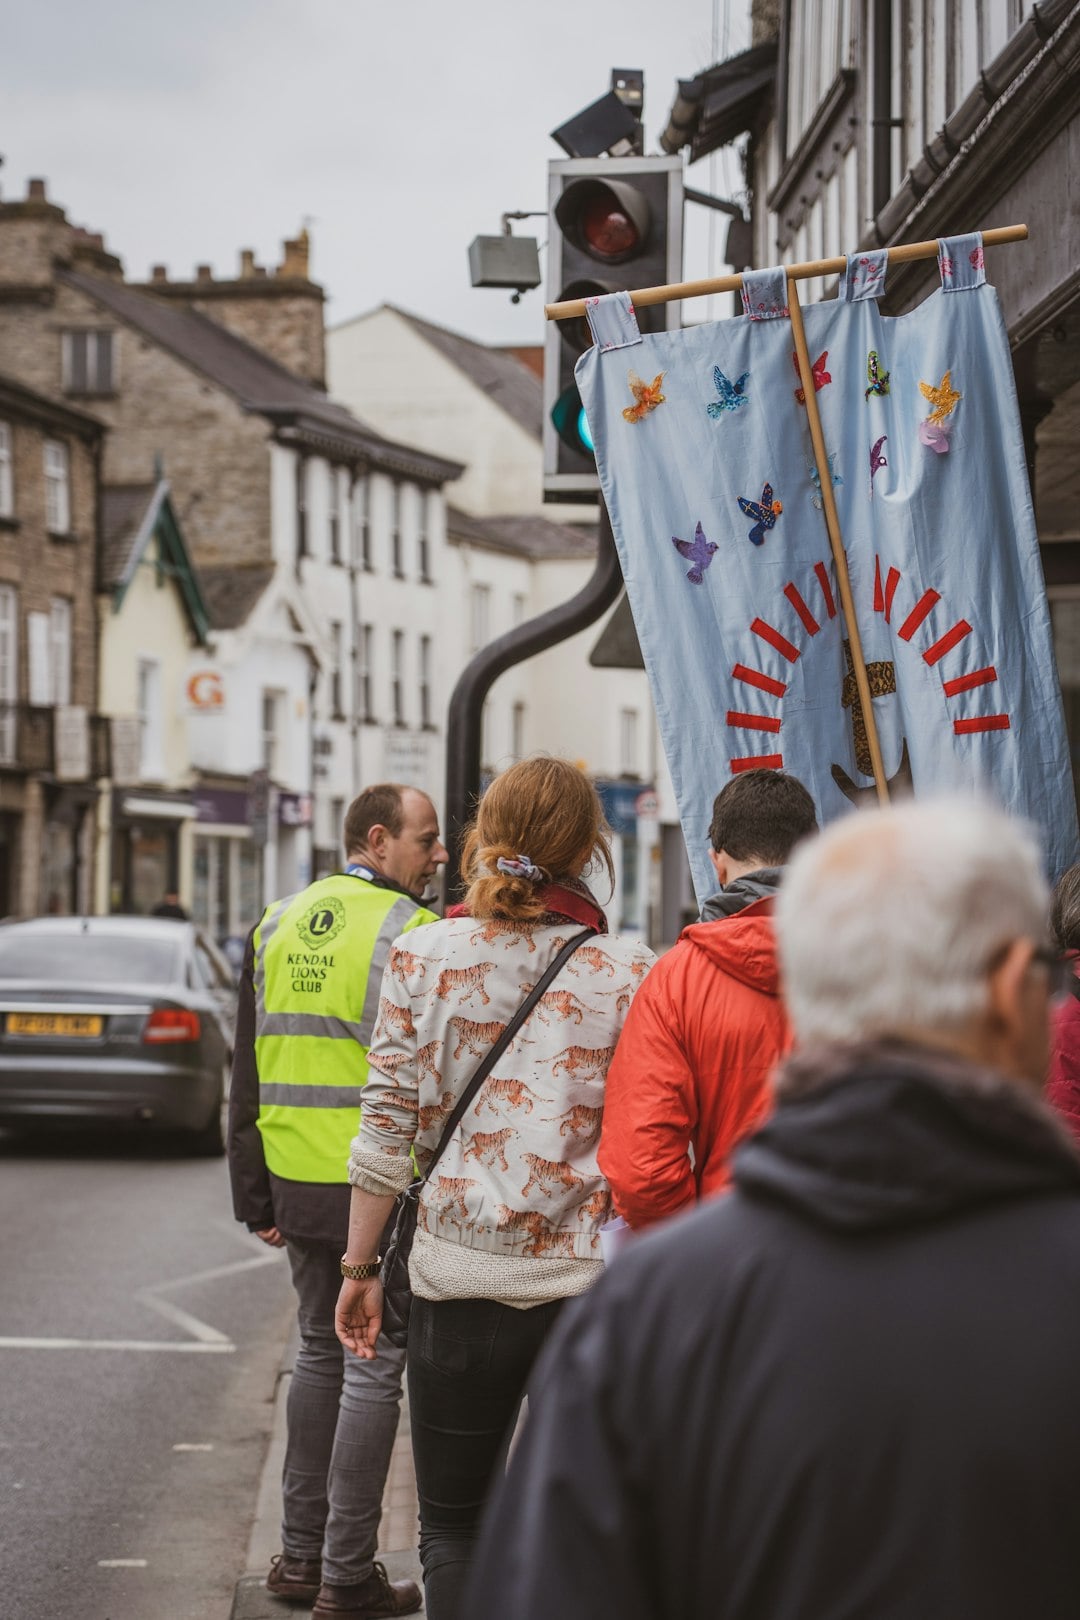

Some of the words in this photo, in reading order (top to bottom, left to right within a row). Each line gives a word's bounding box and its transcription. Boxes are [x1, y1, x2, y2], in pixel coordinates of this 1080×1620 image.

[186, 671, 225, 708] G
[312, 912, 327, 932] L
[287, 954, 335, 967] KENDAL
[291, 967, 327, 979] LIONS
[292, 980, 322, 993] CLUB
